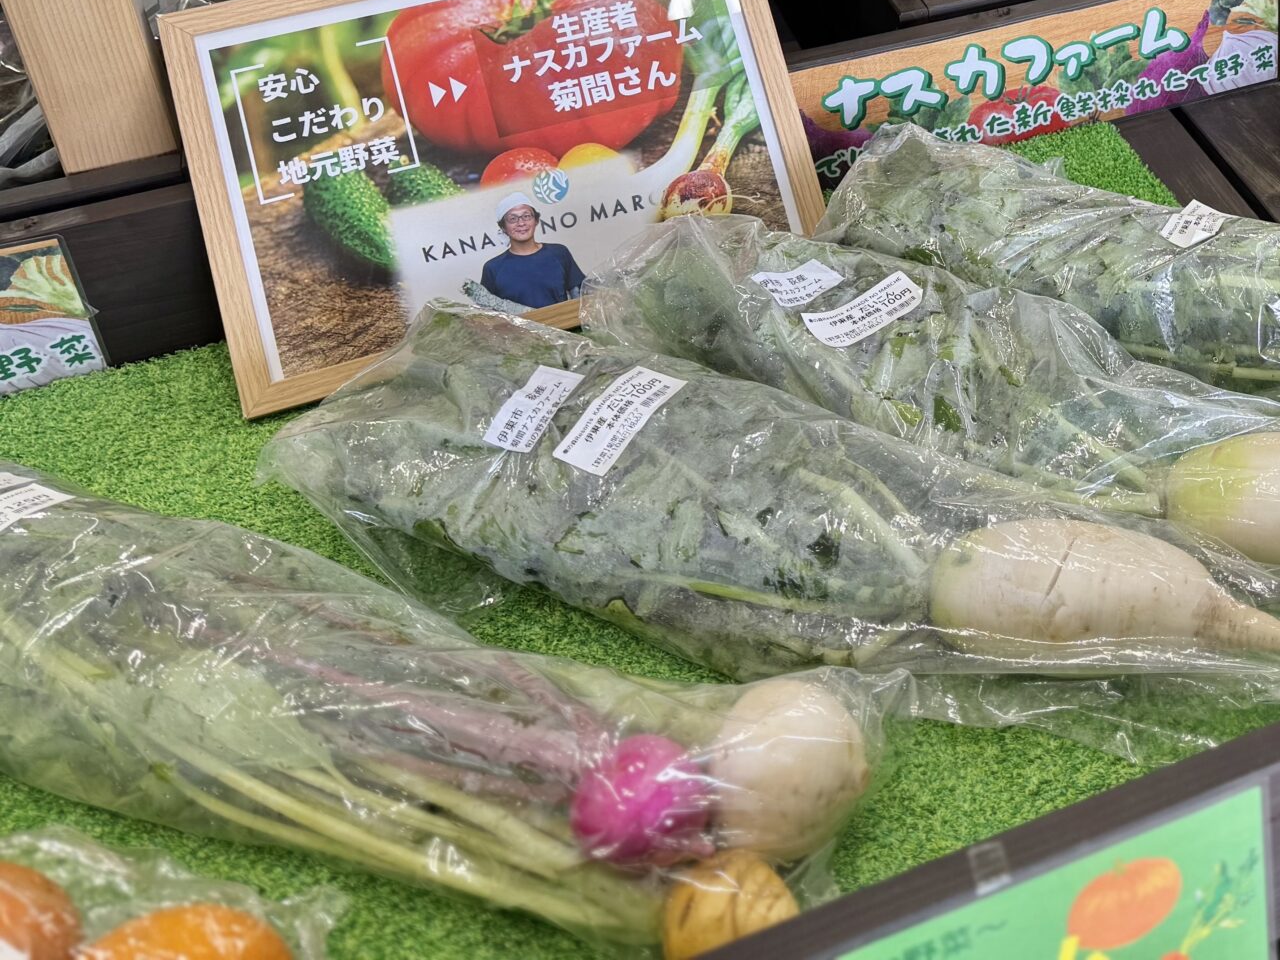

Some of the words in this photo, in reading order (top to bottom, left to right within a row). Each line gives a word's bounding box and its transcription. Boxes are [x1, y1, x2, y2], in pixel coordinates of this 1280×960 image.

[551, 0, 639, 44] 生産者
[501, 18, 704, 84] ナスカファーム
[823, 7, 1191, 130] ナスカファーム
[257, 66, 320, 104] 安心
[547, 59, 678, 115] 菊間さん
[271, 95, 386, 143] こだわり
[276, 134, 402, 187] 地元野菜
[538, 211, 578, 234] NO
[858, 289, 895, 314] だいこん
[606, 381, 642, 412] だいこん
[630, 375, 662, 401] 100円
